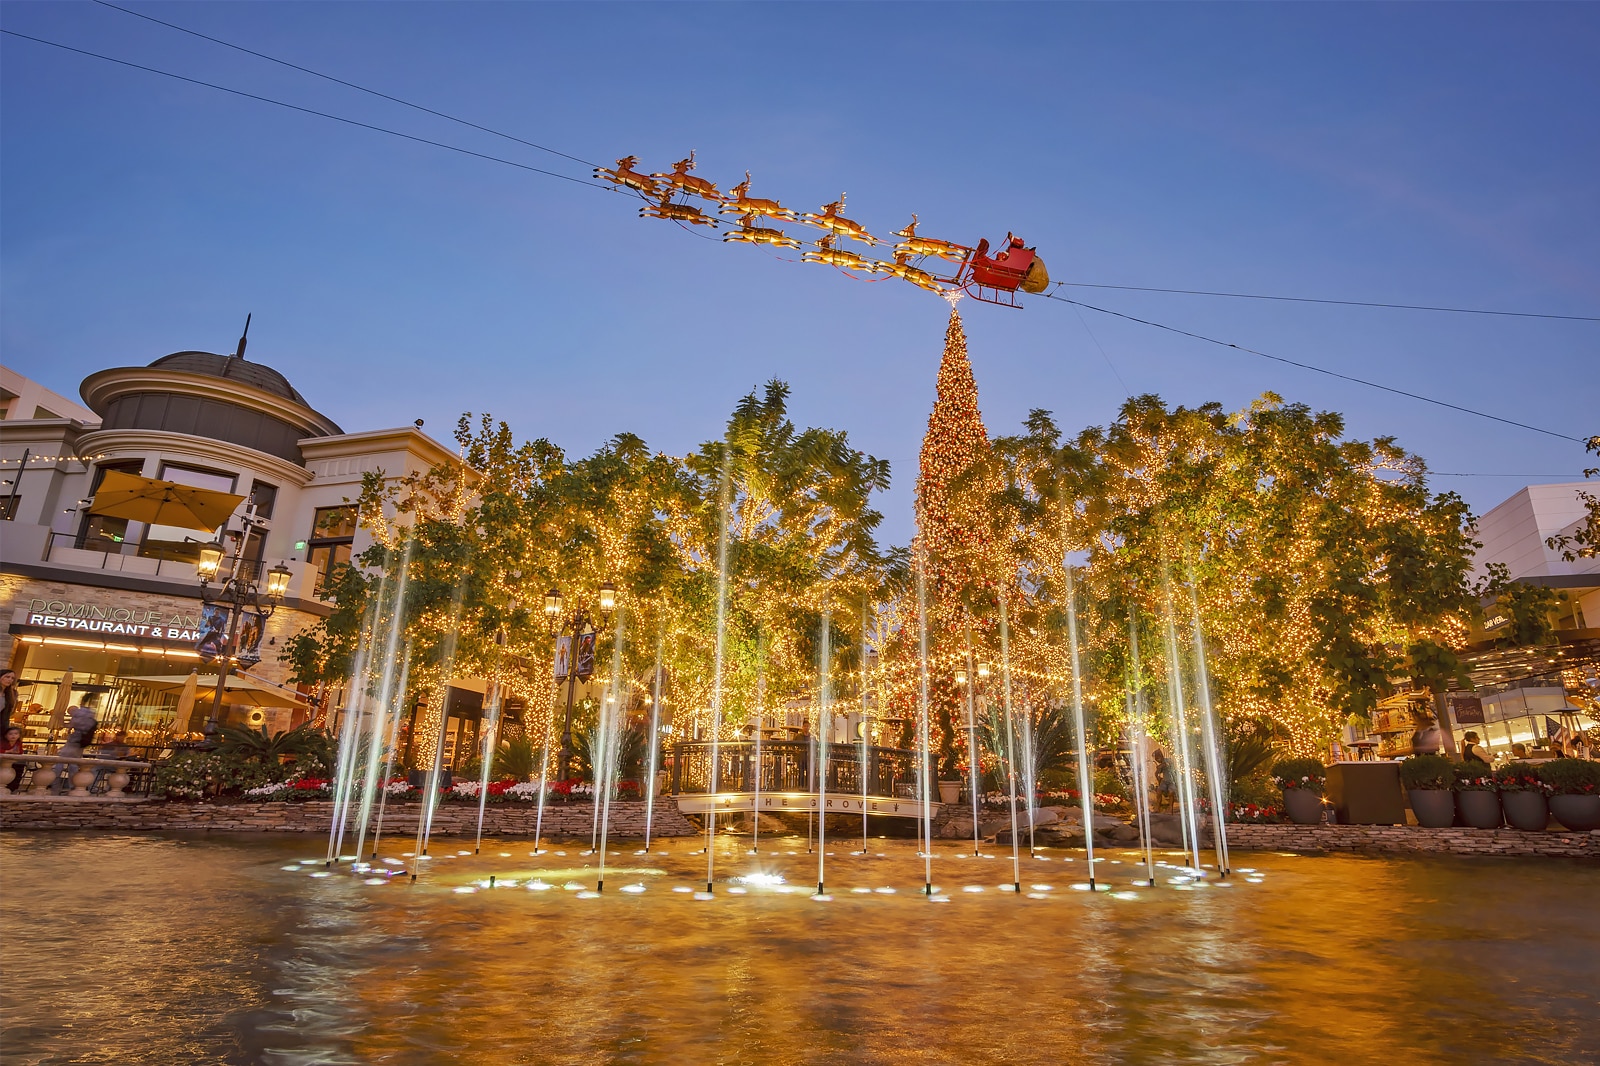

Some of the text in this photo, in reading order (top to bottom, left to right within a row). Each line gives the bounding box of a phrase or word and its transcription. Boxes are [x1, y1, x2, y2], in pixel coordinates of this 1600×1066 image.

[29, 598, 200, 629] DOMINIQUE AN
[30, 614, 201, 641] RESTAURANT & BAK
[749, 798, 878, 810] THE GROVE
